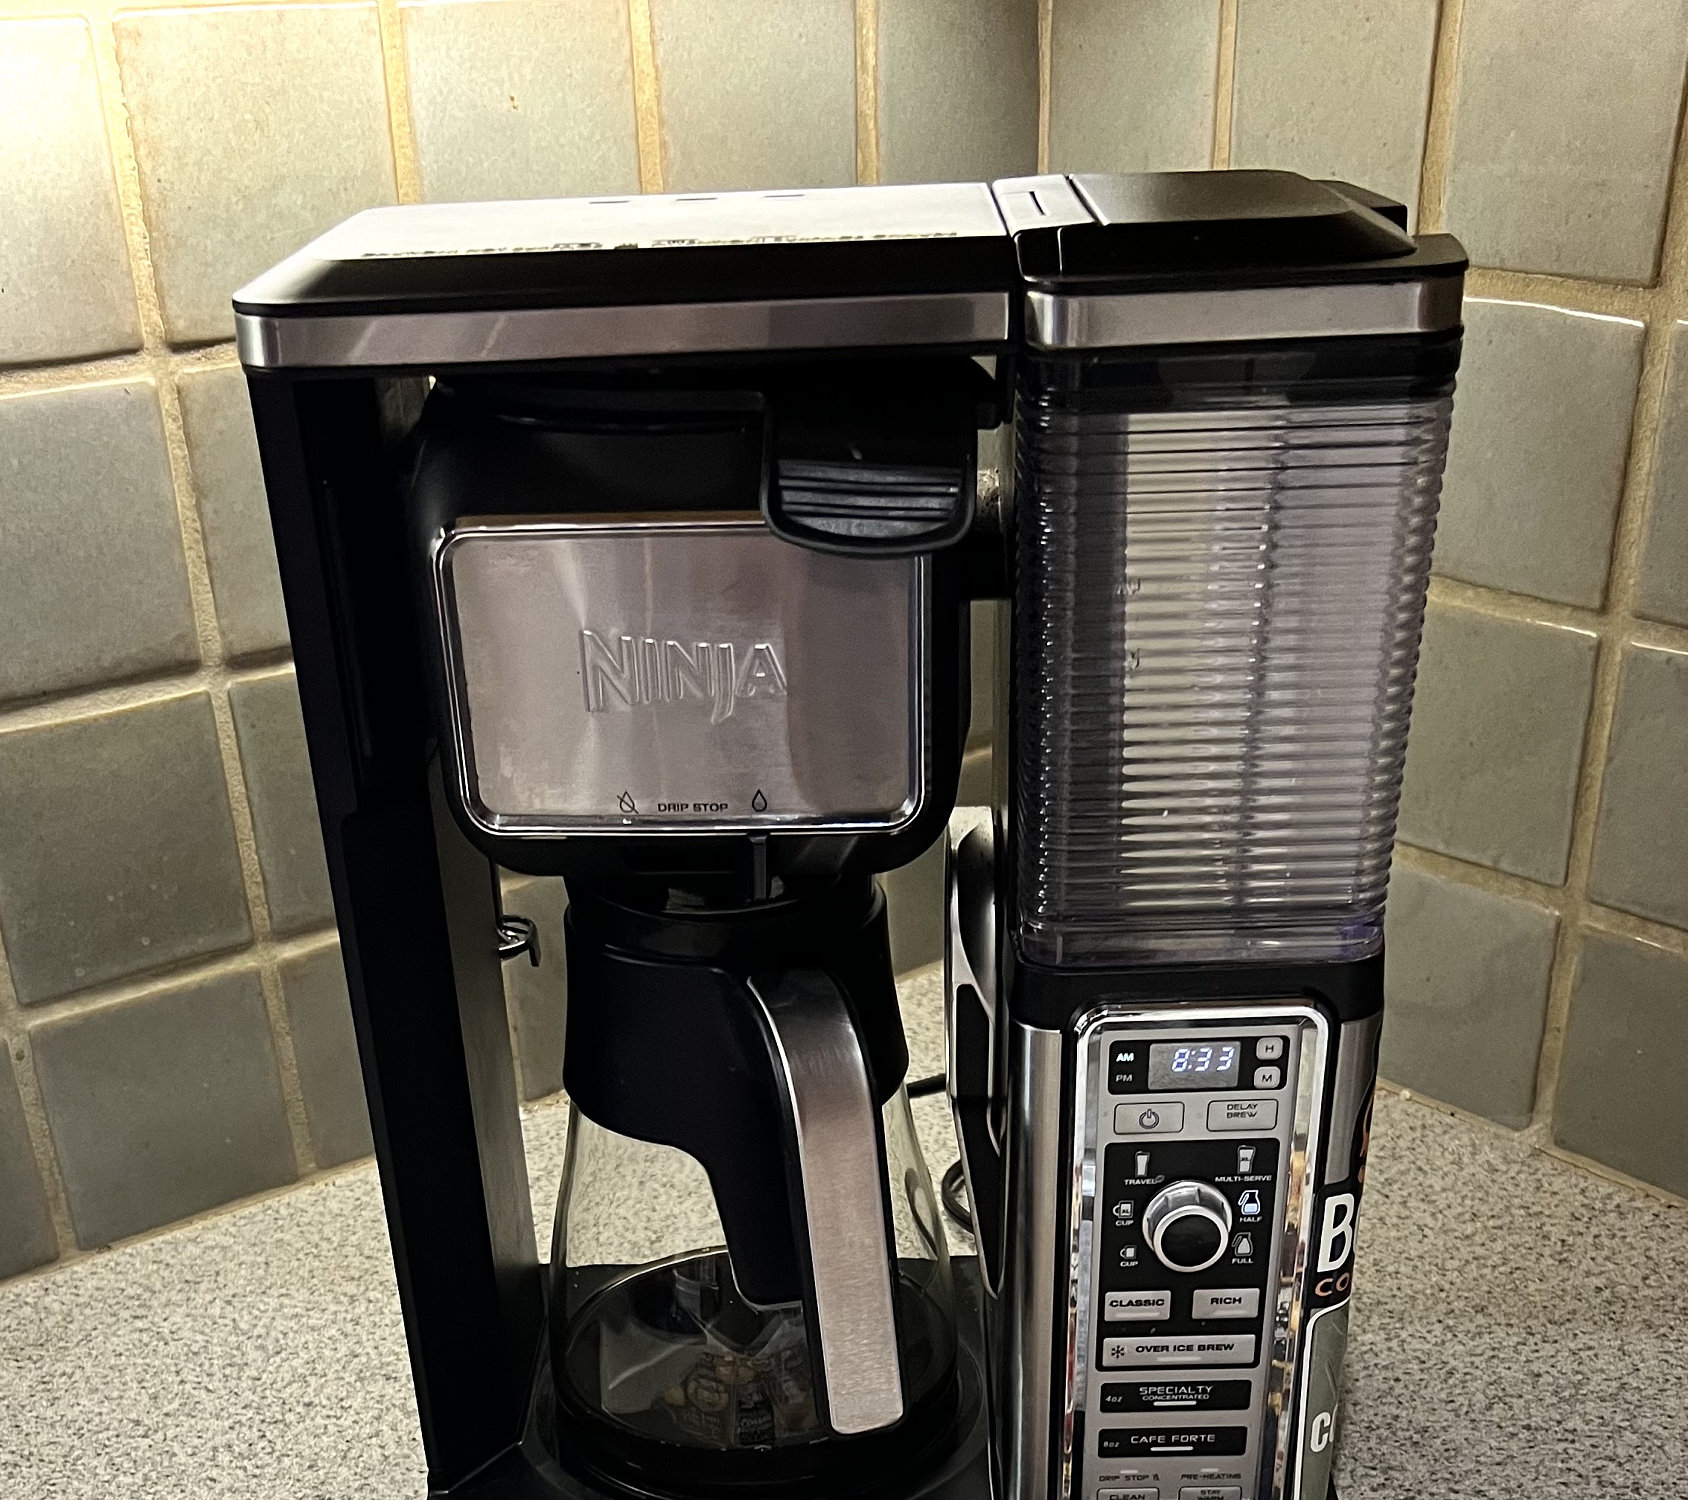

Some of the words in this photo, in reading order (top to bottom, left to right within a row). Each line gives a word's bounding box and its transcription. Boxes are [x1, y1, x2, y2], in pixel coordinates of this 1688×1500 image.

[579, 629, 788, 725] NINJA
[657, 803, 689, 813] DRIP
[693, 802, 729, 813] STOP
[1264, 1044, 1274, 1053] H
[1116, 1052, 1134, 1062] AM
[1171, 1046, 1235, 1073] 8:33
[1115, 1073, 1133, 1083] PM
[1261, 1073, 1273, 1083] M
[1226, 1103, 1258, 1111] DELAY
[1226, 1111, 1258, 1119] BREW
[1124, 1178, 1156, 1186] TRAVEL
[1215, 1174, 1272, 1183] MULTI-SERVE
[1231, 1257, 1254, 1265] FULL
[1109, 1298, 1165, 1308] CLASSIC
[1210, 1296, 1242, 1306] RICH
[1135, 1344, 1170, 1353] OVER
[1172, 1343, 1194, 1353] ICE
[1197, 1342, 1235, 1352] BREW
[1139, 1385, 1214, 1395] SPECIALTY
[1130, 1435, 1166, 1444] CAFE
[1171, 1434, 1216, 1443] FORTE
